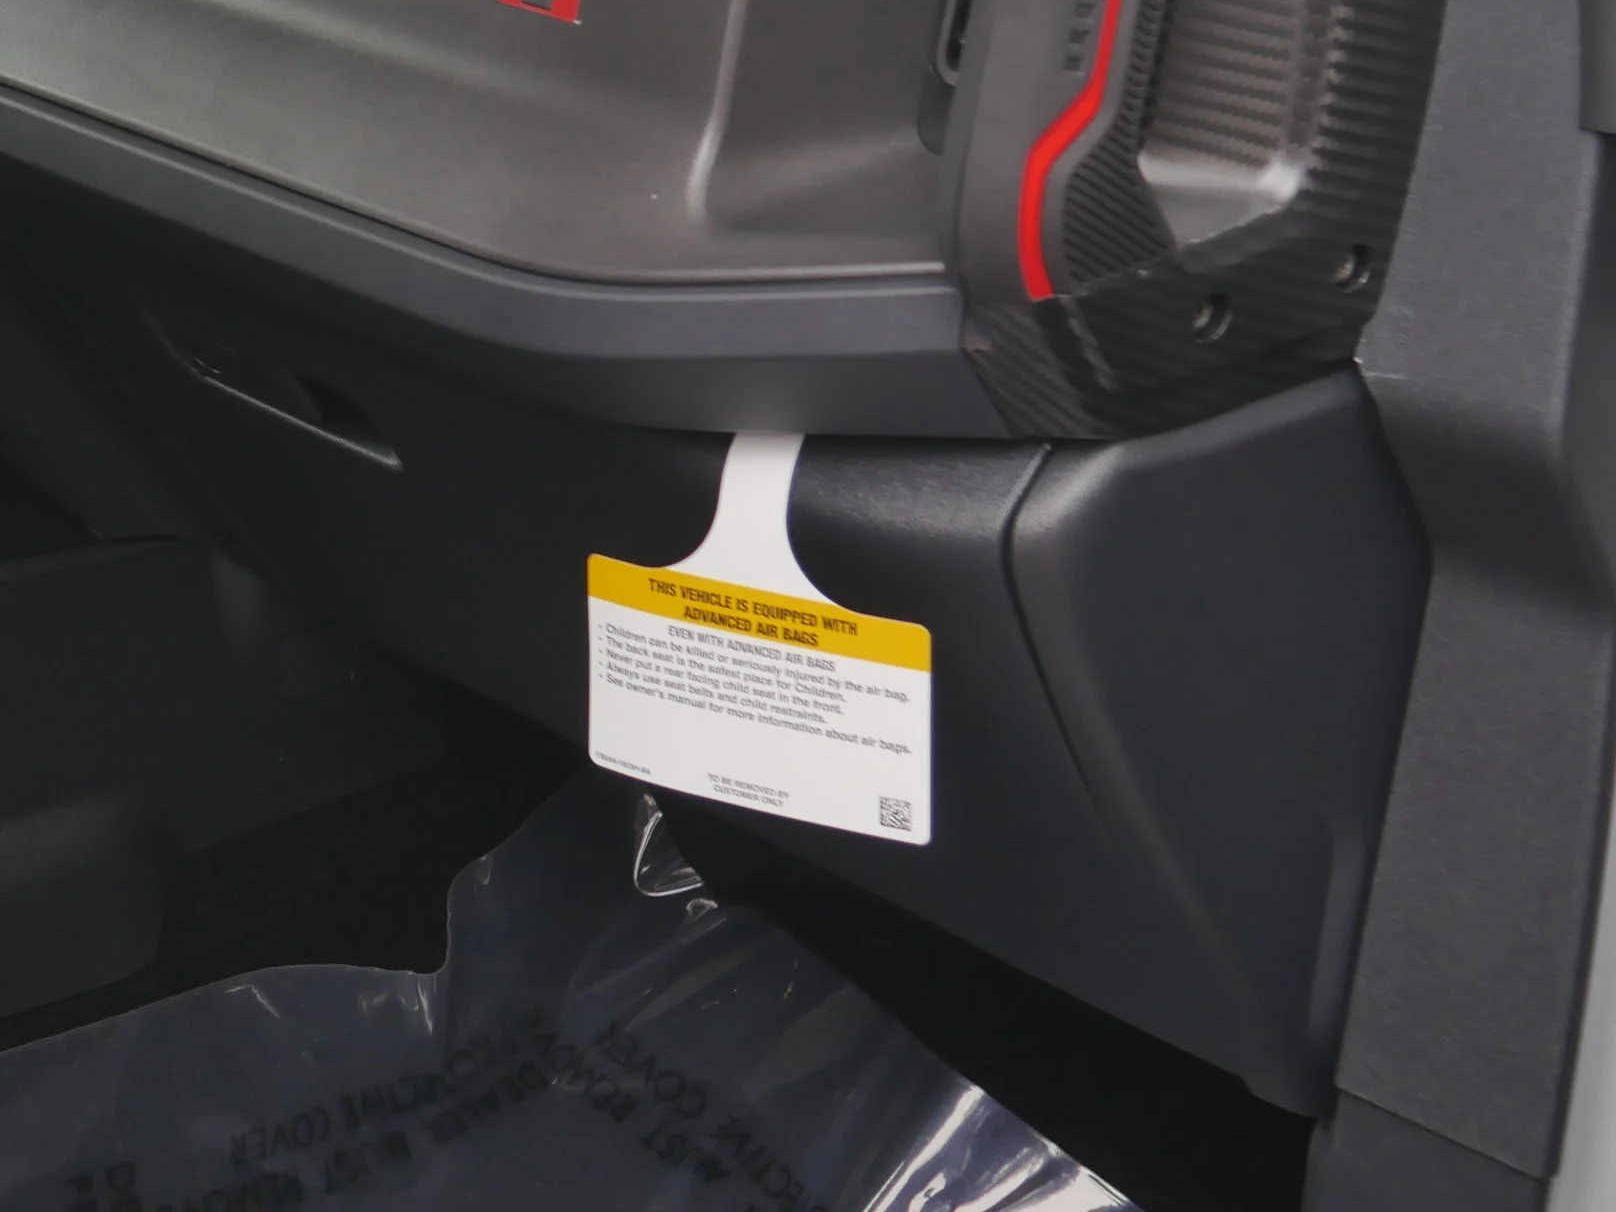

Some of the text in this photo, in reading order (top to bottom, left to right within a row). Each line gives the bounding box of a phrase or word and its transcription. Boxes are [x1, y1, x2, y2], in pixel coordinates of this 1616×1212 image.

[648, 577, 858, 637] THIS VEHICLE IS EQUIPPED WITH
[683, 604, 818, 648] ADVANCED AIR BAGS
[606, 622, 646, 643] Children
[648, 636, 667, 649] can
[671, 640, 683, 653] be
[686, 643, 714, 660] killed
[717, 652, 729, 664] or
[732, 654, 782, 677] seriously
[785, 666, 824, 687] injured
[827, 675, 842, 690] by
[845, 679, 863, 693] the
[866, 684, 881, 698] air
[606, 635, 623, 649] The
[626, 642, 648, 657] back
[652, 649, 674, 664] seat
[676, 654, 684, 665] is
[689, 658, 704, 671] the
[708, 662, 740, 679] safest
[744, 670, 773, 689] place
[776, 677, 790, 691] for
[606, 648, 632, 665] Never
[635, 657, 651, 672] put
[664, 665, 683, 679] rear
[688, 669, 719, 690] facing
[722, 677, 749, 695] child
[753, 685, 776, 700] seat
[780, 691, 789, 703] in
[793, 693, 810, 708] the
[668, 625, 836, 673] EVEN WITH ADVANCED AIR BAGS
[606, 660, 640, 682] Always
[643, 674, 660, 686] use
[664, 677, 685, 692] seat
[688, 682, 714, 699] belts
[717, 690, 736, 705] and
[739, 695, 766, 712] child
[606, 672, 623, 686] See
[625, 680, 664, 699] owner's
[667, 690, 705, 709] manual
[709, 701, 722, 713] for
[726, 706, 754, 721] more
[758, 711, 822, 737] information
[825, 725, 858, 745] about
[861, 734, 876, 748] air
[707, 772, 789, 800] TO BE REMOVED BY
[713, 783, 784, 808] CUSTOMER ONLY
[229, 1105, 330, 1168] COVER
[323, 1129, 413, 1195] MUST
